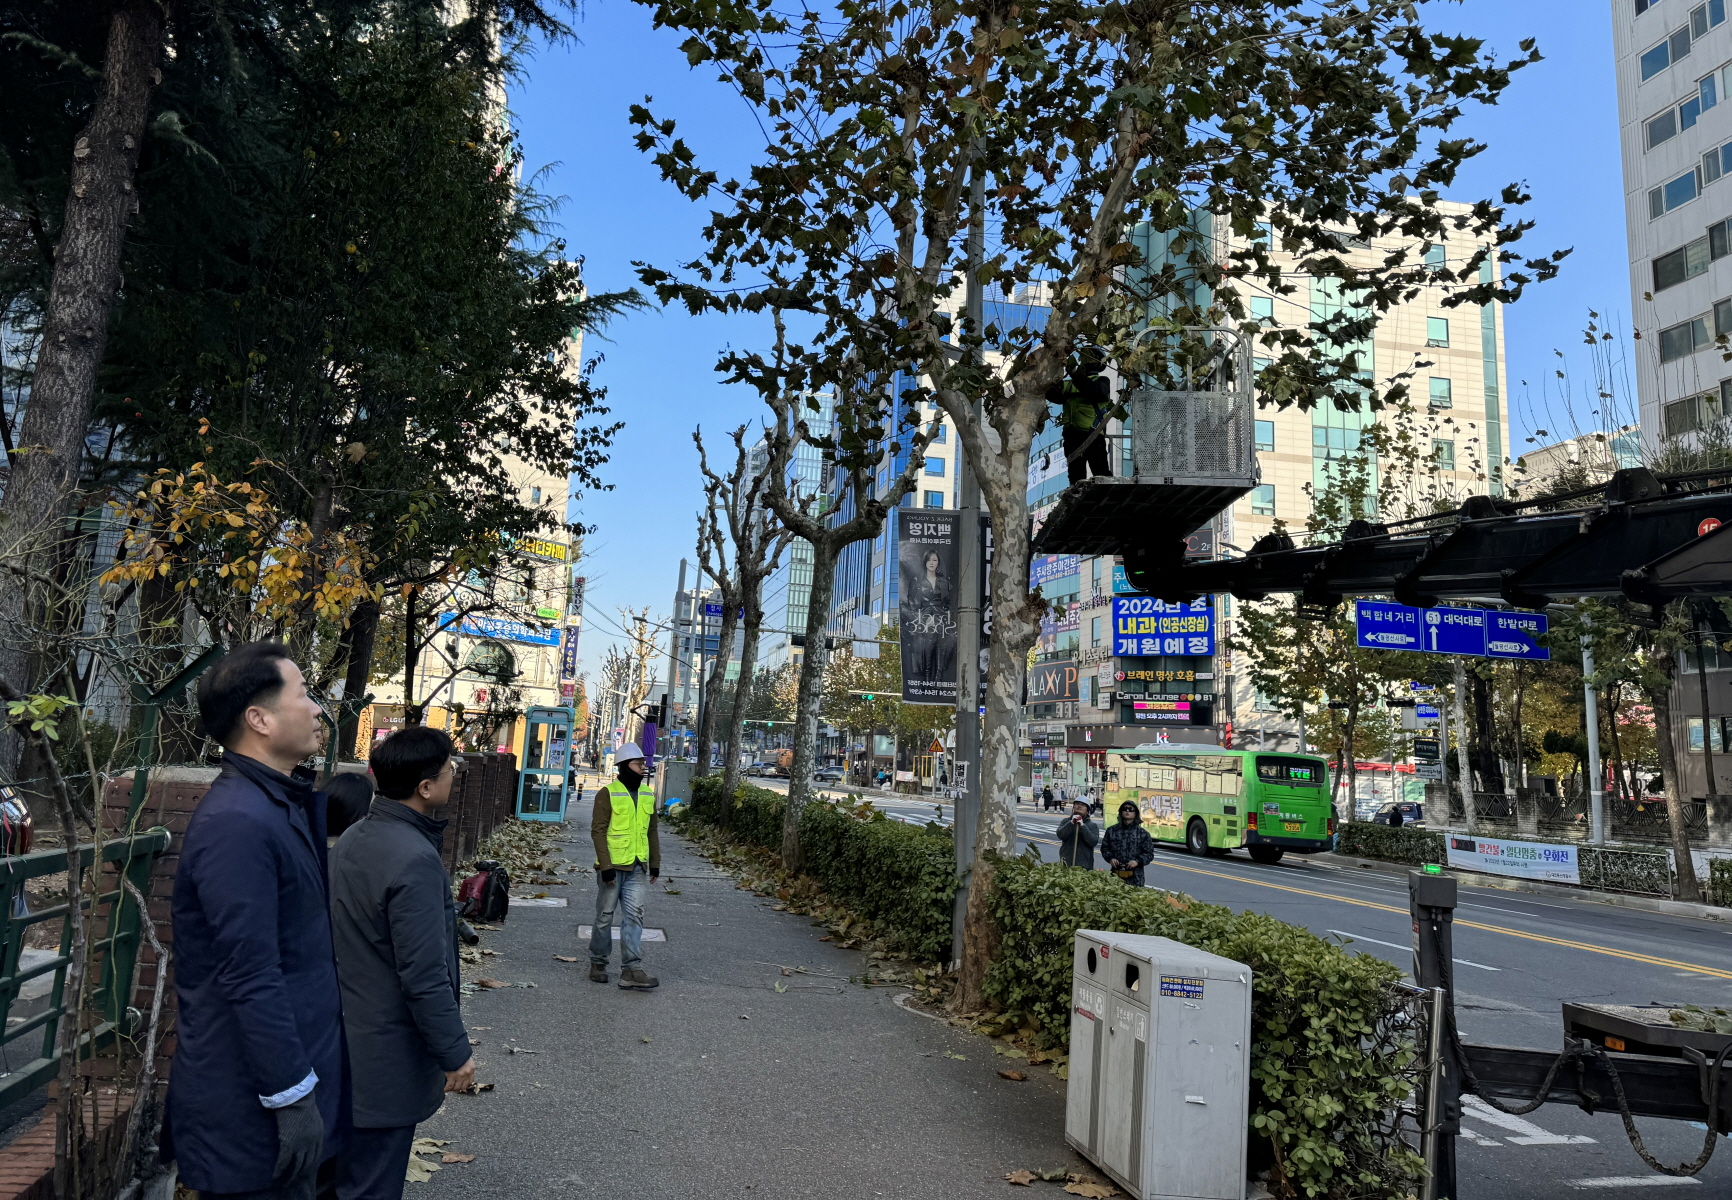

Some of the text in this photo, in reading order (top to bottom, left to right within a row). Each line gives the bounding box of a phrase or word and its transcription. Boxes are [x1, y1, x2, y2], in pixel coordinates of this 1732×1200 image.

[1361, 609, 1415, 624] 백합네거리
[1428, 613, 1439, 622] 51
[1444, 614, 1483, 627] 대덕대로
[1119, 615, 1209, 634] 내과 (인공신장실)
[1497, 617, 1538, 631] 한밭대로
[1119, 637, 1208, 654] 개원예정
[1028, 668, 1061, 697] ALAXY
[1126, 670, 1154, 680] 브레인
[1156, 670, 1175, 682] 명상
[1176, 670, 1195, 681] 호흡
[1116, 691, 1144, 700] Carom
[1145, 691, 1180, 701] Lounge
[1156, 732, 1170, 743] kt
[1150, 795, 1183, 819] 에듀윌
[1478, 843, 1500, 856] 빨간불
[1506, 846, 1537, 860] 일단멈춤
[1543, 849, 1569, 863] 우회전
